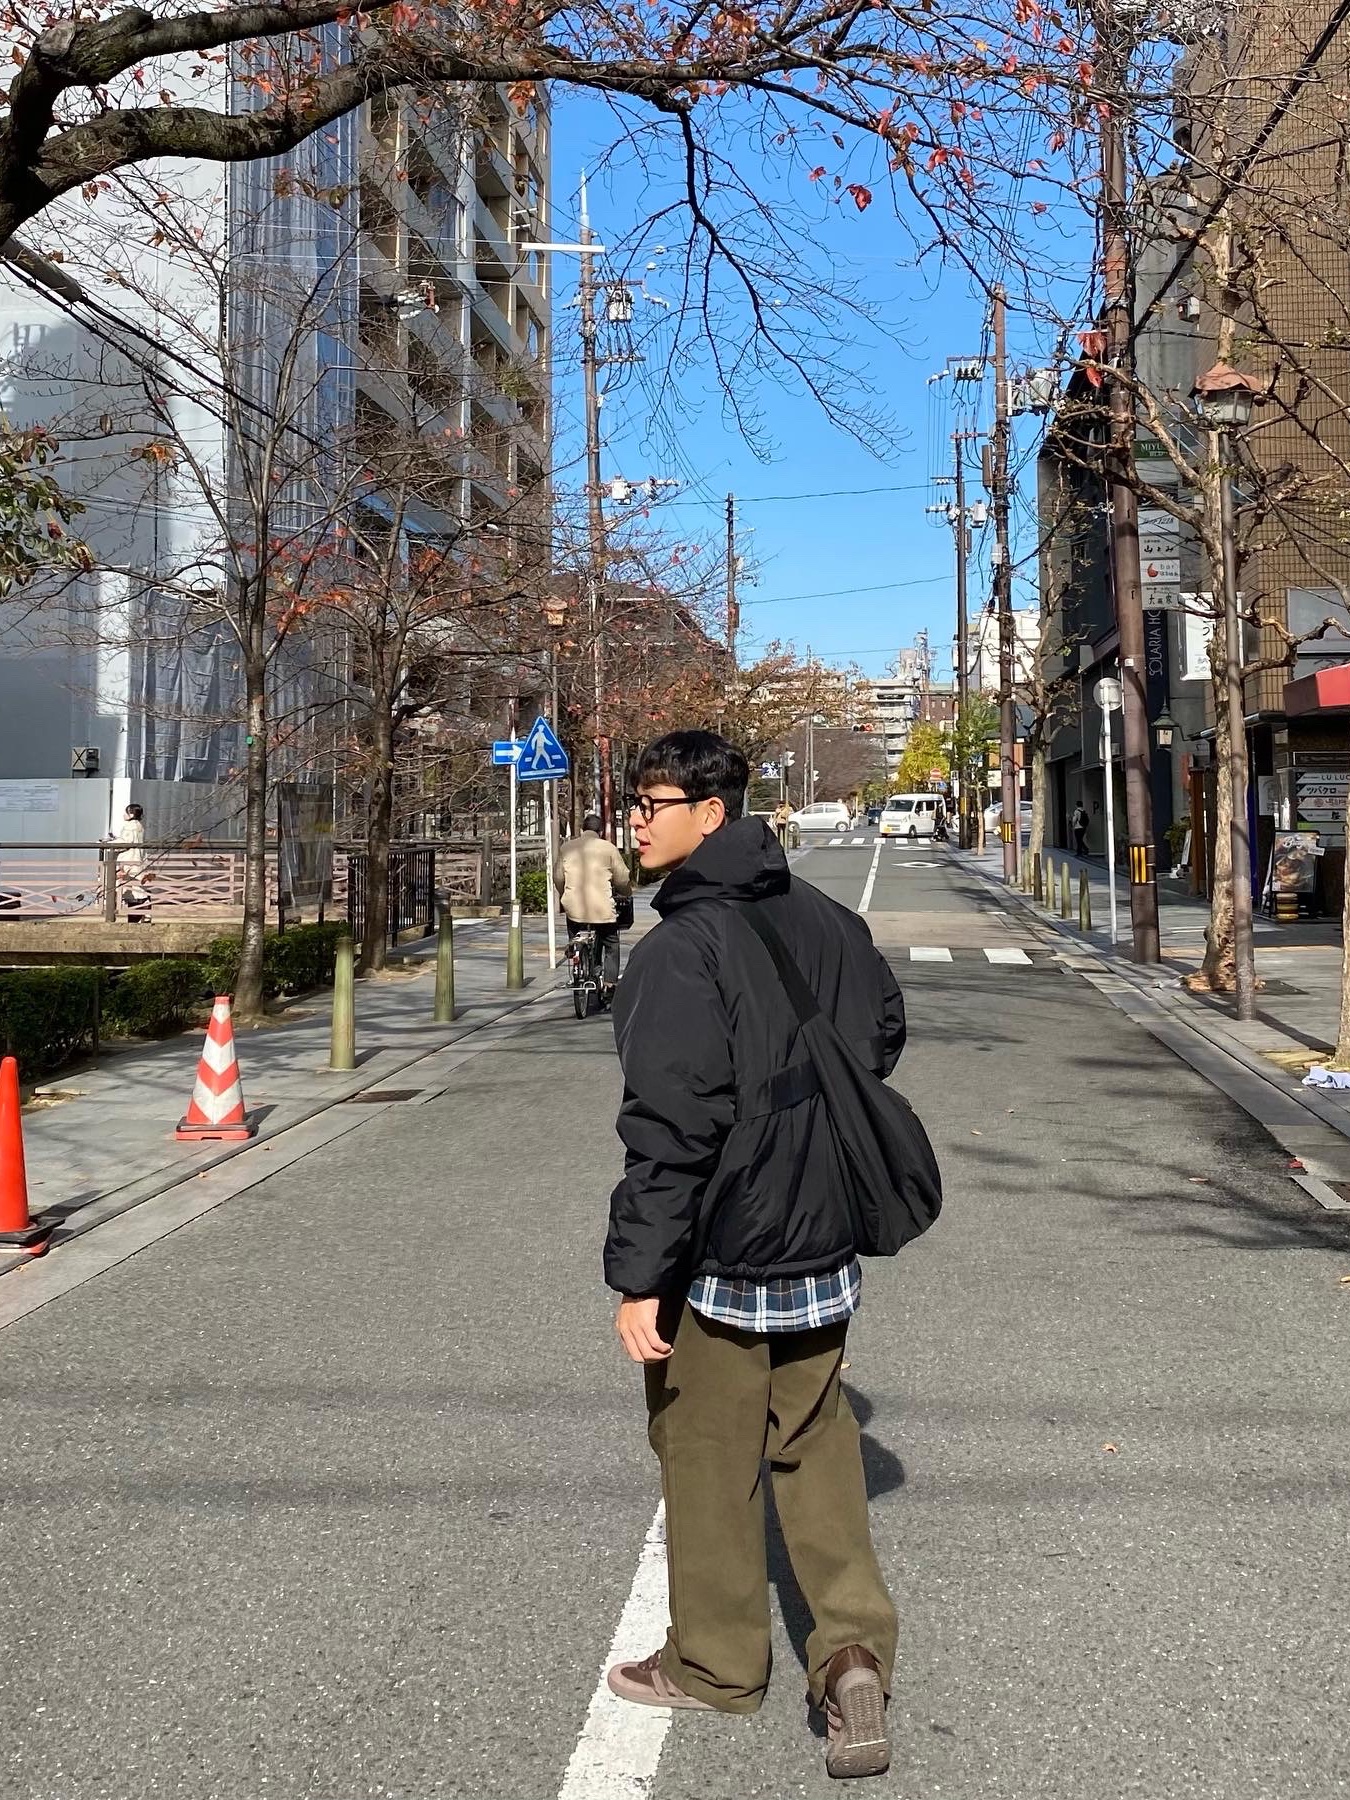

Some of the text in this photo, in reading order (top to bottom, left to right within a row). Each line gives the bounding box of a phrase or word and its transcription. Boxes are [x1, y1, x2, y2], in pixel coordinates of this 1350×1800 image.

[1148, 627, 1163, 677] SOLARIA
[1306, 786, 1337, 795] ツバクロ
